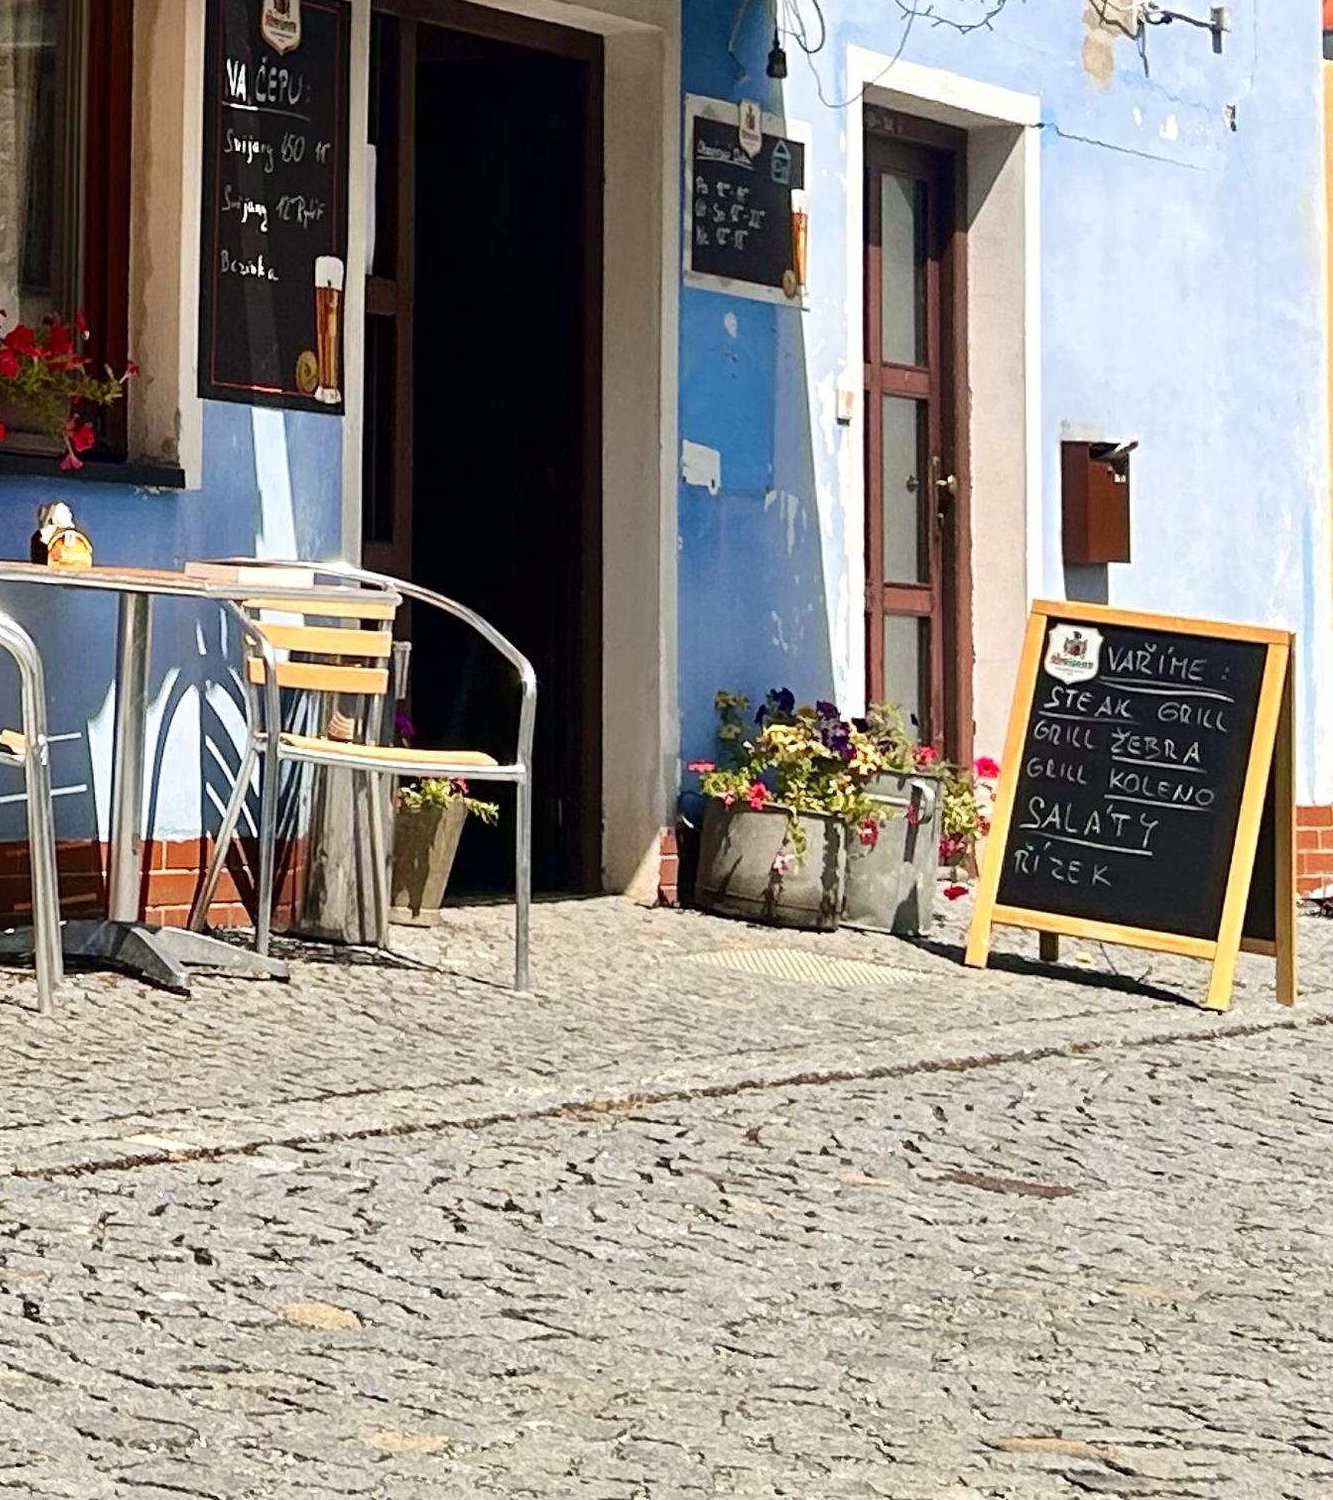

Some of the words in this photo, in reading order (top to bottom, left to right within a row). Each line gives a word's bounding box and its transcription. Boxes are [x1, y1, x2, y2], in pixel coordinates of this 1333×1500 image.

[1043, 686, 1132, 719] STEAK
[1157, 702, 1228, 733] GRILL
[1033, 719, 1095, 750] GRILL
[1111, 727, 1200, 765] ŽEBRA
[1026, 757, 1088, 785] GRILL
[1109, 767, 1215, 806] KOLENO
[1019, 795, 1159, 848] SALÁTY
[1014, 841, 1112, 887] ŘÍZEK
